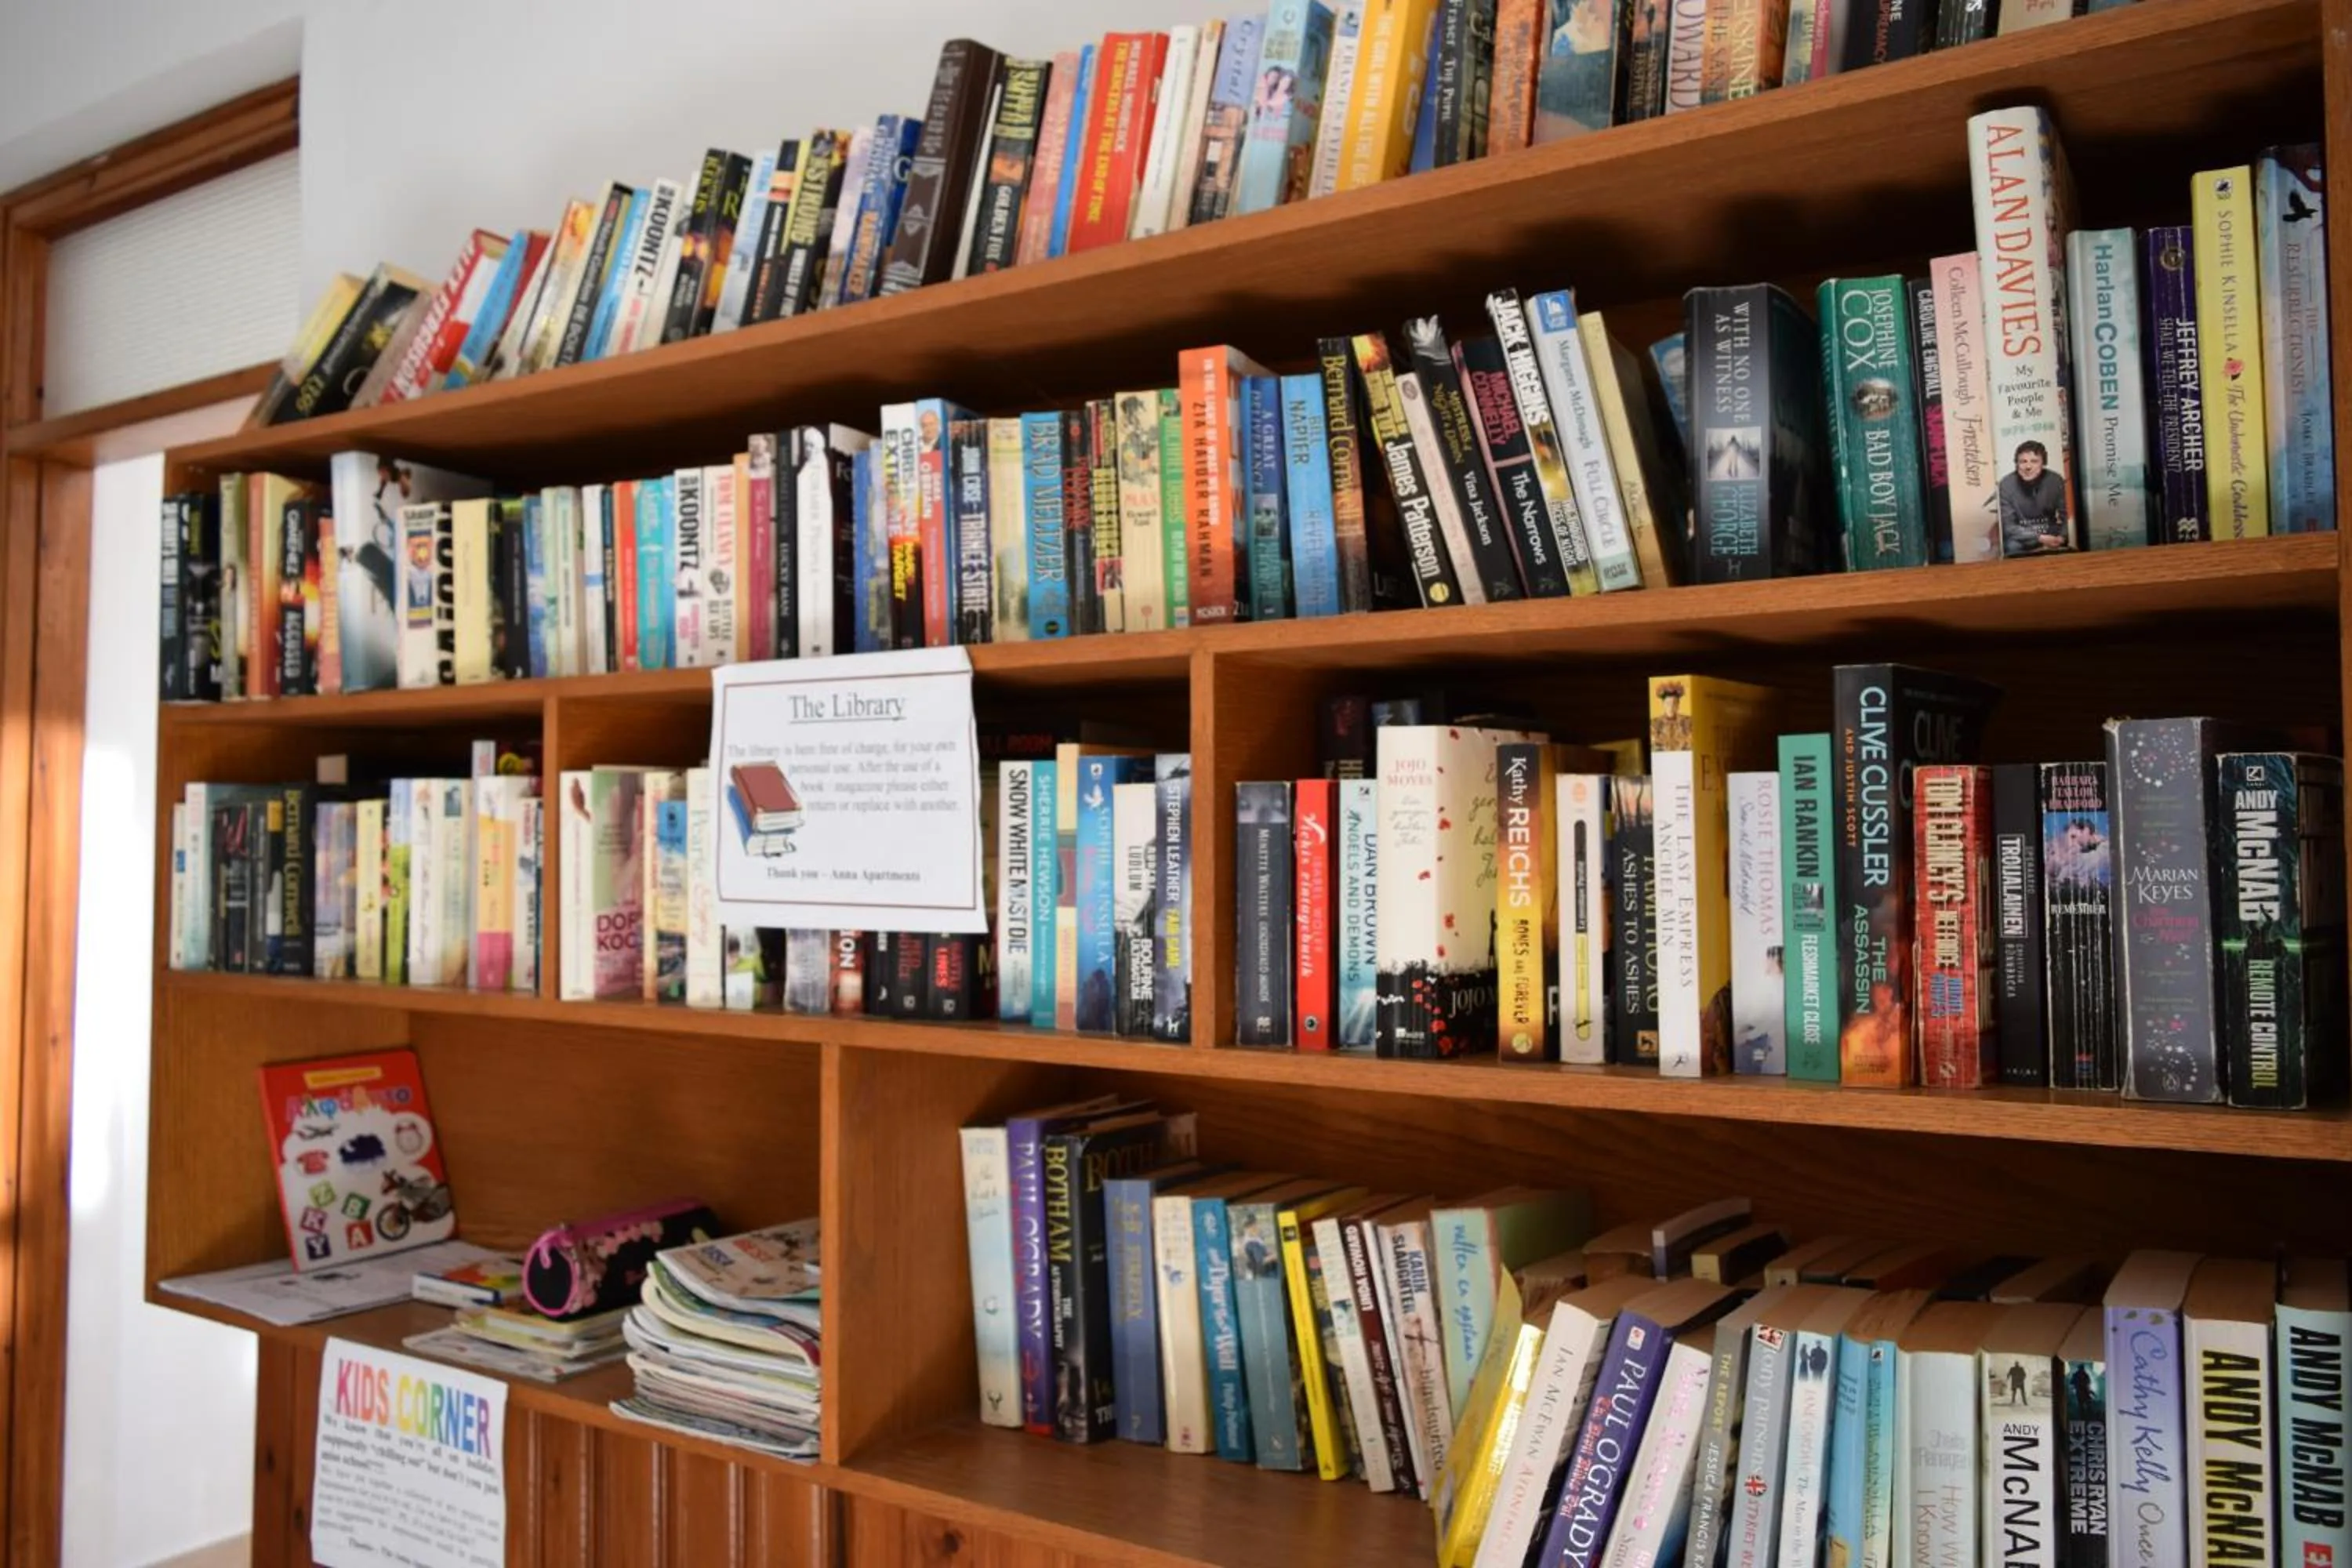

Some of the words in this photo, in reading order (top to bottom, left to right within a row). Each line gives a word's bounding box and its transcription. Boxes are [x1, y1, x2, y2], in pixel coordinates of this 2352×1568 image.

[1227, 20, 1254, 100] Crystal
[1985, 125, 2030, 232] ALAN
[634, 197, 673, 278] KOONTZ
[989, 185, 1012, 234] GOLDEN
[985, 236, 1007, 261] FOX
[2218, 210, 2234, 269] SOPHIE
[2001, 230, 2042, 358] DAVIES
[2092, 244, 2113, 319] Harlan
[395, 292, 451, 394] FERGUSON
[1494, 296, 1526, 350] JACK
[1715, 314, 1730, 333] AS
[1733, 301, 1751, 349] WITH
[1842, 289, 1877, 373] COX
[1867, 288, 1898, 369] JOSEPHINE
[1918, 289, 1933, 347] CAROLINE
[2158, 318, 2177, 347] SHALL
[2221, 276, 2238, 353] KINSELLA
[1204, 373, 1215, 391] THE
[1715, 339, 1732, 414] WITNESS
[1733, 354, 1749, 381] NO
[1924, 349, 1941, 399] ENGVALL
[2093, 321, 2120, 411] COBEN
[2160, 349, 2178, 369] WE
[2161, 371, 2180, 393] TELL
[2176, 316, 2198, 392] JEFFREY
[1204, 395, 1215, 427] LIGHT
[1322, 356, 1347, 432] Bernard
[1471, 370, 1506, 446] CONNELLY
[1492, 371, 1519, 441] MICHAEL
[1508, 351, 1549, 426] HIGGINS
[1556, 339, 1577, 389] Margaret
[1567, 390, 1592, 451] McDonagh
[1733, 387, 1751, 423] ONE
[2162, 394, 2179, 413] THE
[961, 445, 979, 474] JOHN
[1029, 421, 1061, 479] BRAD
[1206, 430, 1216, 442] OF
[1206, 445, 1218, 472] WHAT
[1250, 389, 1264, 495] DELIVERANCE
[1289, 400, 1310, 465] NAPIER
[1864, 429, 1892, 467] BAD
[2103, 416, 2122, 477] Promise
[2163, 415, 2181, 474] PRESIDENT?
[2180, 397, 2205, 471] ARCHER
[963, 476, 982, 503] CASE
[1207, 477, 1218, 494] WE
[1329, 435, 1358, 521] Cornwell
[1464, 470, 1481, 499] Vina
[1511, 471, 1530, 499] The
[1867, 471, 1896, 510] BOY
[2106, 482, 2122, 507] Me
[679, 488, 699, 571] KOONTZ
[1032, 485, 1064, 583] MELTZER
[1209, 495, 1220, 525] KNOW
[1385, 441, 1423, 495] James
[1407, 495, 1442, 579] Patterson
[1470, 500, 1493, 546] Jackson
[1519, 500, 1548, 565] Narrows
[1710, 486, 1738, 557] GEORGE
[1740, 484, 1759, 555] ELIZABETH
[1867, 512, 1900, 555] JACK
[286, 510, 300, 576] GIMENEZ
[779, 543, 789, 583] LUCKY
[781, 586, 789, 617] MAN
[962, 571, 988, 614] STATE
[285, 611, 302, 679] ACCUSED
[789, 695, 825, 719] The
[833, 692, 905, 721] Library
[1857, 685, 1888, 760] CLIVE
[728, 745, 746, 757] The
[750, 745, 779, 757] library
[1845, 728, 1855, 755] AND
[1008, 769, 1027, 821] SNOW
[1504, 757, 1527, 804] Kathy
[1675, 782, 1690, 820] THE
[1793, 754, 1817, 793] IAN
[1846, 758, 1856, 804] JUSTIN
[1924, 775, 1962, 814] TOM
[2234, 789, 2277, 811] ANDY
[282, 789, 304, 858] Bernard
[1037, 775, 1051, 842] SHERRIE
[1166, 784, 1181, 843] STEPHEN
[1756, 779, 1773, 841] ROSIE
[1846, 807, 1857, 848] SCOTT
[1861, 764, 1889, 888] CUSSLER
[1008, 823, 1028, 878] WHITE
[1508, 808, 1530, 909] REICHS
[1676, 835, 1693, 884] LAST
[1795, 798, 1820, 879] RANKIN
[1926, 817, 1965, 902] CLANCY'S
[2234, 810, 2281, 924] McNAB
[767, 868, 797, 880] Thank
[800, 869, 818, 882] you
[830, 869, 858, 880] Anna
[862, 869, 920, 882] Apartments
[1008, 879, 1027, 925] MUST
[1036, 847, 1051, 922] HEWSON
[1166, 845, 1180, 902] LEATHER
[1621, 848, 1638, 912] ASHES
[1759, 846, 1776, 937] THOMAS
[2126, 866, 2198, 884] MARIAN
[2138, 884, 2194, 904] KEYES
[1008, 927, 1027, 954] DIE
[1624, 916, 1639, 946] TO
[1678, 896, 1694, 989] EMPRESS
[1853, 903, 1870, 1014] ASSASSIN
[1871, 936, 1886, 982] THE
[1626, 951, 1639, 1014] ASHES
[1801, 933, 1819, 1009] FLESHMARKET
[2246, 959, 2277, 1018] REMOTE
[1803, 1011, 1820, 1045] CLOSE
[2250, 1022, 2279, 1089] CONTROL
[1015, 1141, 1037, 1203] PAUL
[1044, 1145, 1072, 1263] BOTHAM
[1020, 1216, 1041, 1340] O'GRADY
[1552, 1345, 1574, 1379] IAN
[1719, 1353, 1732, 1377] THE
[1754, 1348, 1778, 1389] tony
[2118, 1330, 2167, 1419] Cathy
[2289, 1326, 2343, 1411] ANDY
[337, 1358, 390, 1427] KIDS
[397, 1374, 491, 1459] CORNER
[1526, 1384, 1561, 1459] McEWAN
[1605, 1357, 1647, 1429] PAUL
[1711, 1382, 1729, 1434] REPORT
[2201, 1348, 2262, 1450] ANDY
[1746, 1396, 1770, 1474] parsons
[2003, 1423, 2040, 1436] ANDY
[2087, 1421, 2106, 1482] CHRIS
[2070, 1421, 2086, 1534] EXTREME
[2120, 1425, 2171, 1494] Kelly
[2291, 1417, 2344, 1529] McNAB
[1561, 1436, 1621, 1568] O'GRADY
[2088, 1484, 2106, 1535] RYAN
